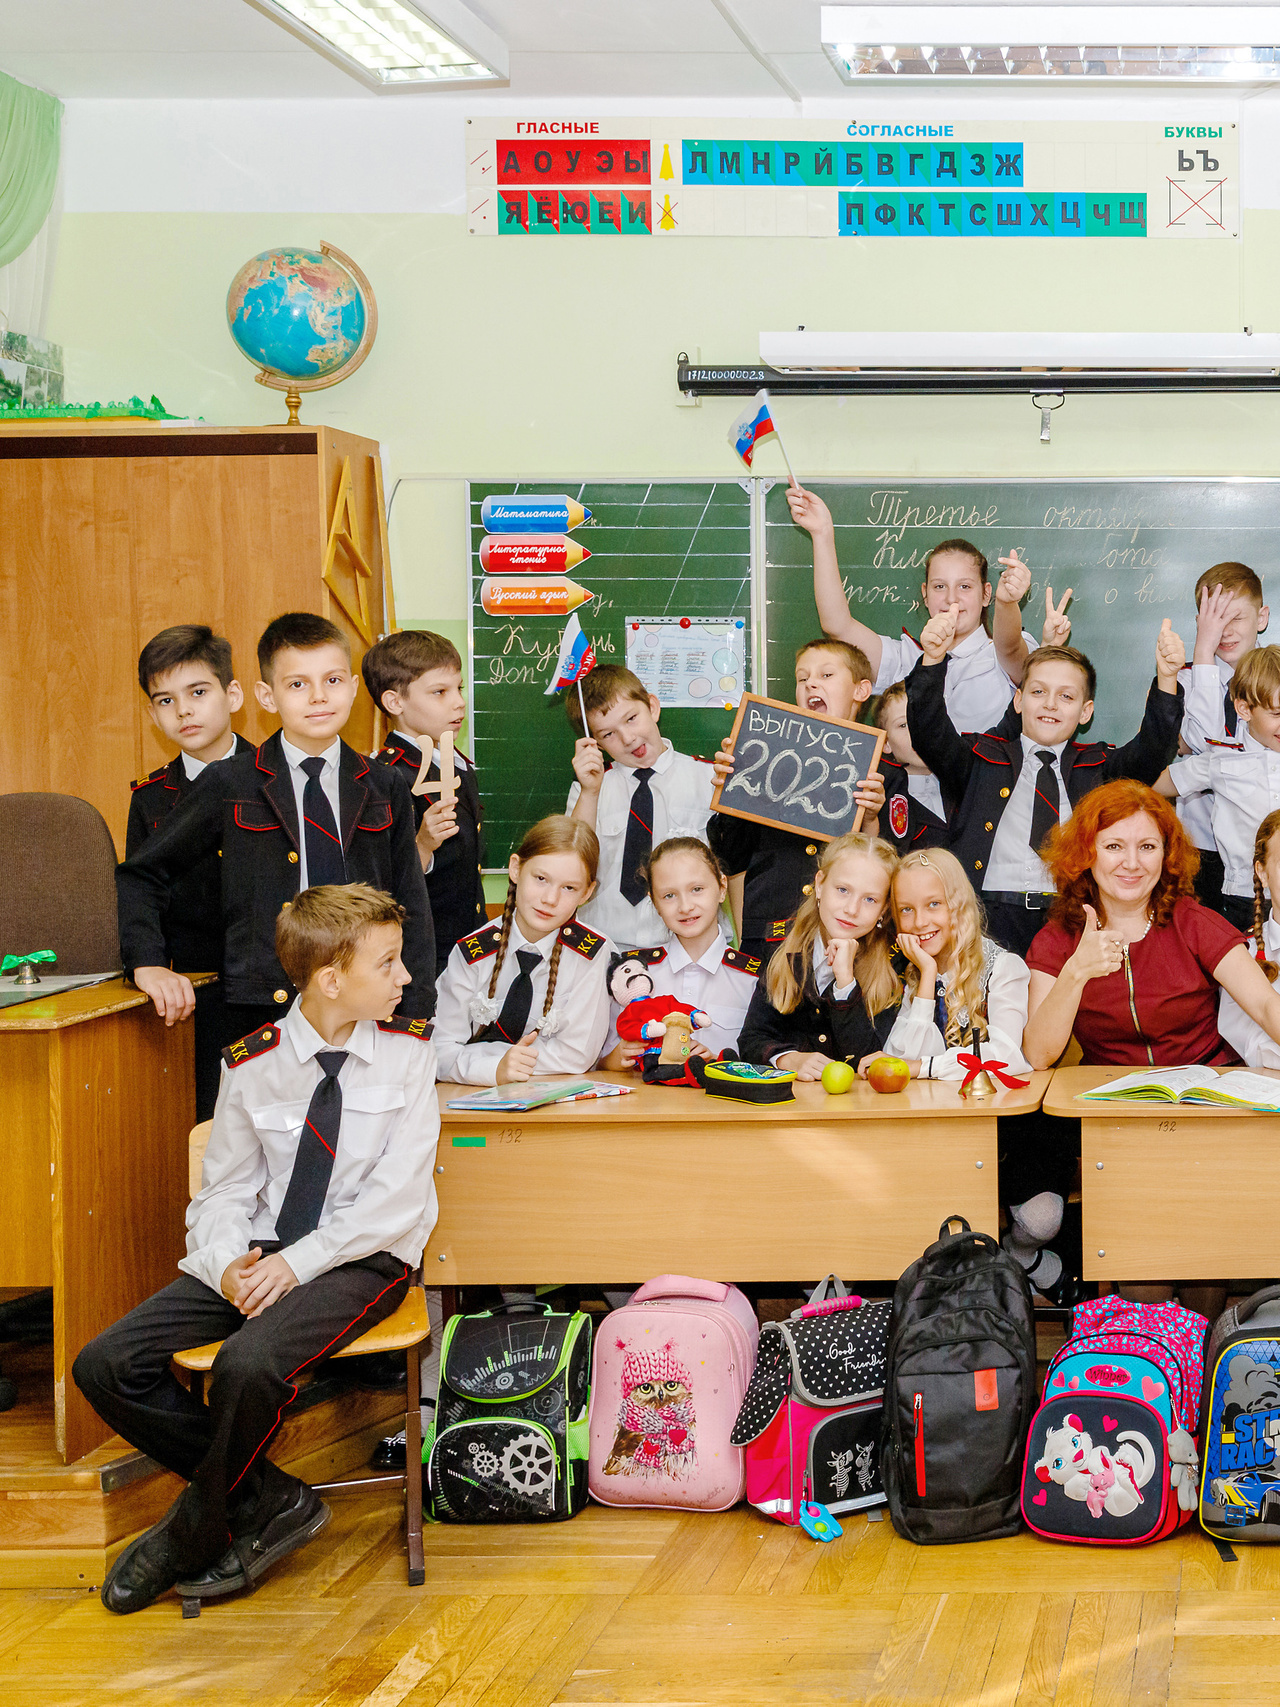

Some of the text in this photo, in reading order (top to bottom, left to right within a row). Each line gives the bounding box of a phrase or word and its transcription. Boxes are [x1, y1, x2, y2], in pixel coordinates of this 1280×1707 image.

[516, 121, 600, 134] ГЛАСНЫЕ
[846, 124, 954, 137] СОГЛАСНЫЕ
[1164, 126, 1223, 139] БУКВЫ
[489, 506, 570, 519] Математика
[867, 491, 1000, 540] Третье
[488, 542, 567, 558] Литературное
[509, 555, 547, 564] чтение
[489, 586, 569, 605] Русский язык
[749, 709, 863, 763] ВЫПУСК
[725, 738, 861, 820] 2023
[1158, 1120, 1177, 1133] 132
[498, 1128, 523, 1144] 132
[829, 1341, 857, 1360] Good
[1089, 1368, 1128, 1383] Winner
